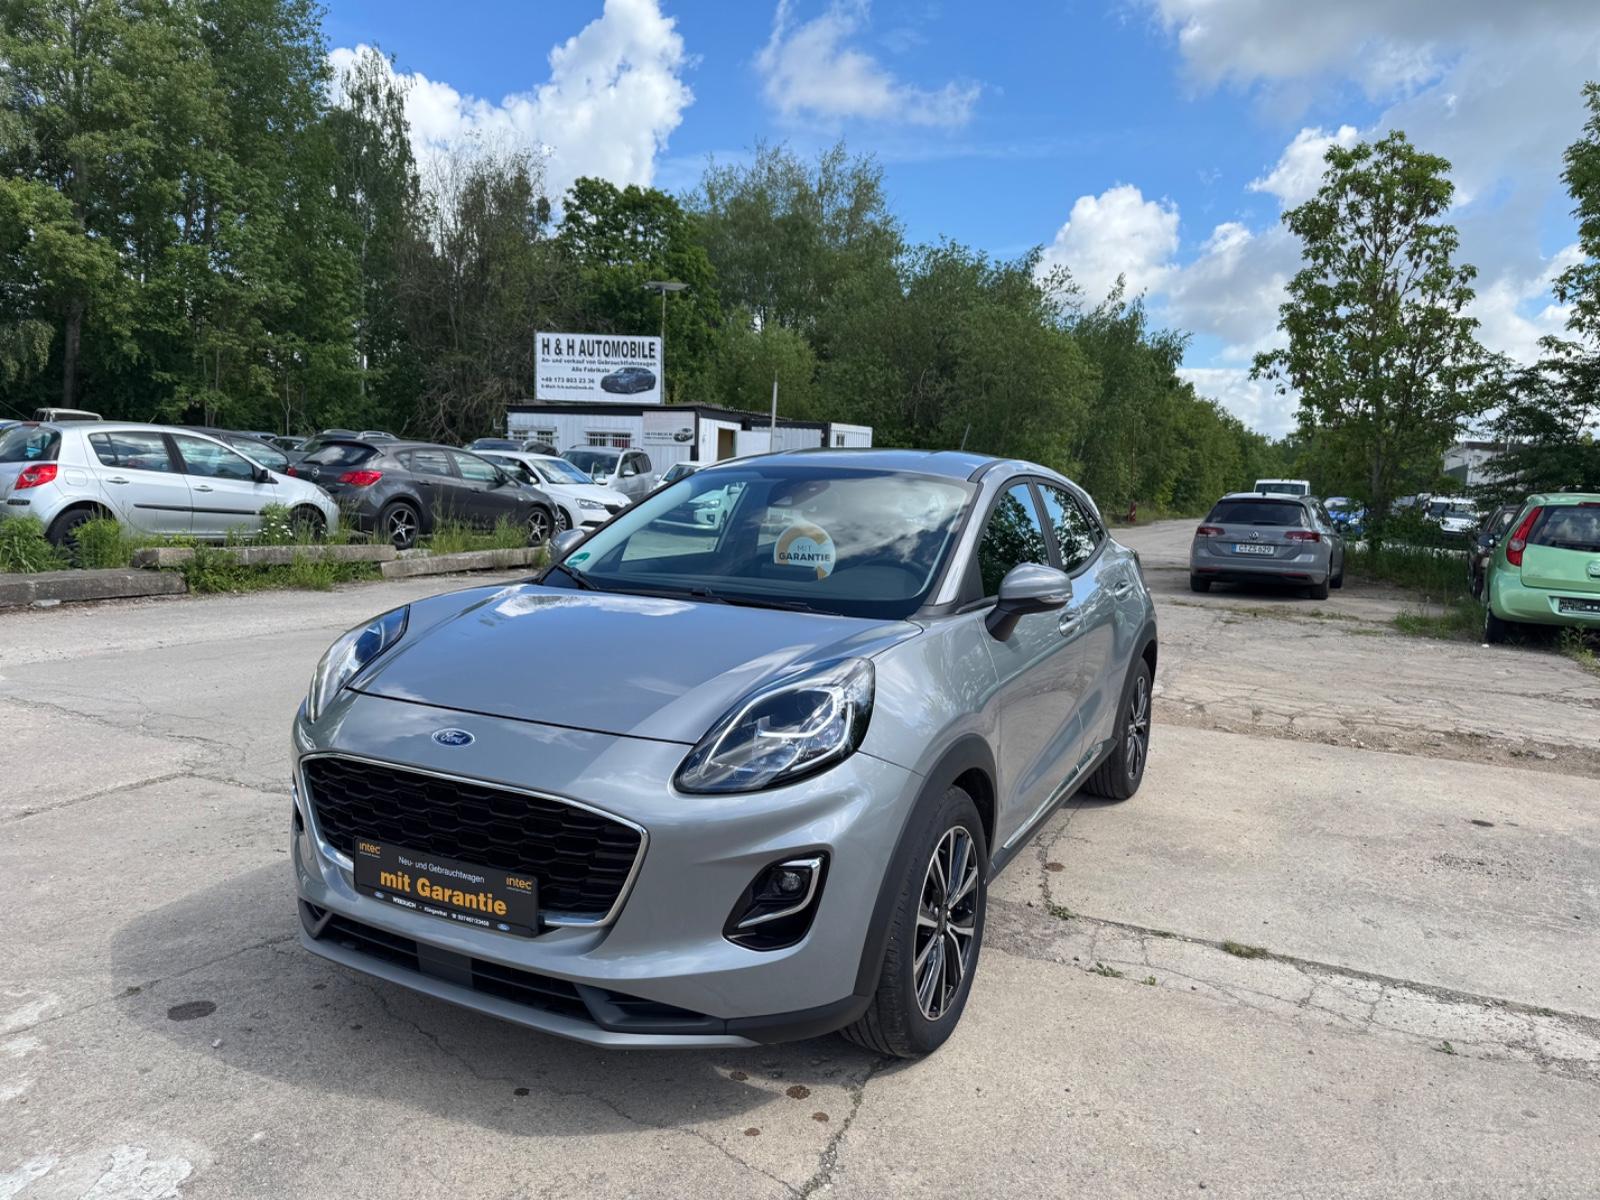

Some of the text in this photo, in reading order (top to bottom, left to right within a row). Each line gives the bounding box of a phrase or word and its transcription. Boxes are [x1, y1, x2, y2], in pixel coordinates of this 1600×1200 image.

[541, 338, 656, 359] H & H AUTOMOBILE
[778, 552, 830, 561] GARANTIE
[359, 842, 381, 854] intec
[398, 856, 485, 884] Neu- und Gebrauchtwagen
[506, 876, 532, 890] intec
[380, 870, 507, 915] mit Garantie
